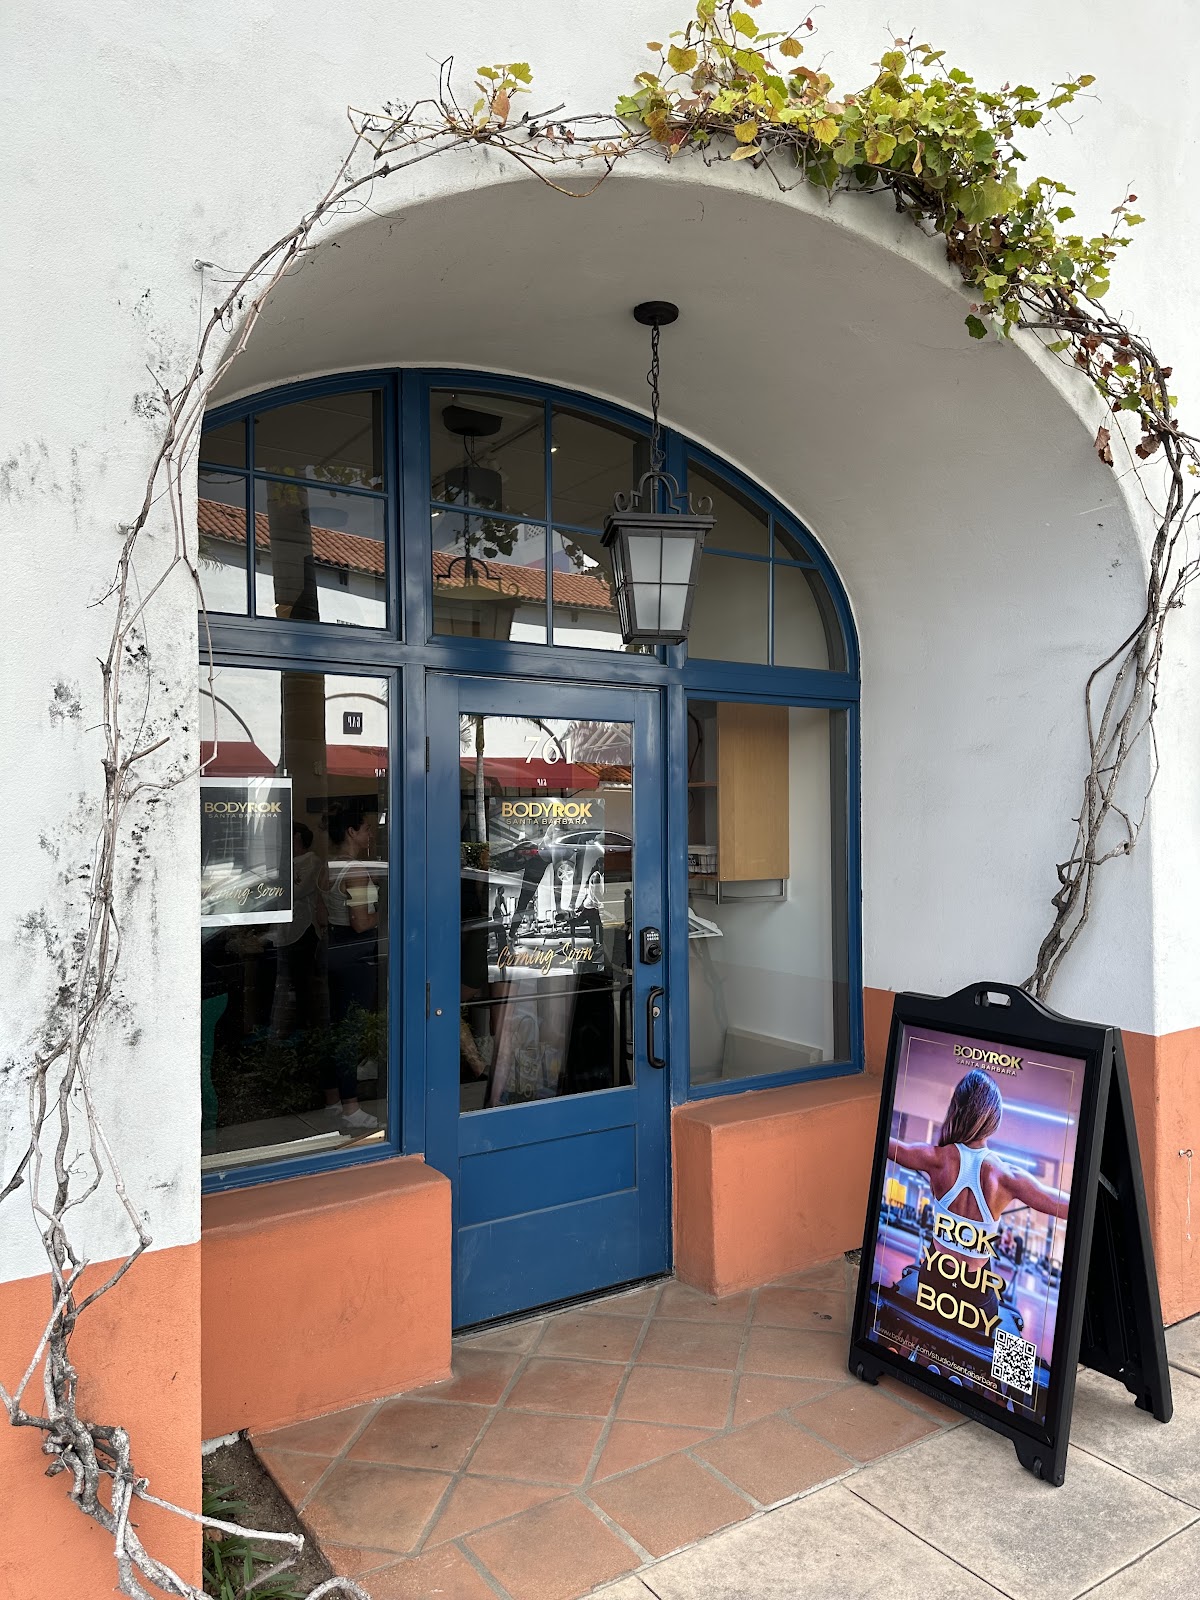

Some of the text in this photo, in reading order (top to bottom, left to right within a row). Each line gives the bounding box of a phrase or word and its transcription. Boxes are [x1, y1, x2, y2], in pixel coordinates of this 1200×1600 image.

[523, 734, 576, 765] 761
[204, 801, 282, 813] BODYROK
[501, 801, 593, 818] BODYROK
[506, 818, 588, 826] SANTA BARBARA
[254, 882, 285, 900] Soon
[497, 941, 594, 976] Coming Soon
[953, 1044, 1022, 1070] BODYROK
[955, 1057, 1017, 1076] SANTA BARBARA
[934, 1212, 1000, 1258] ROK
[923, 1245, 1006, 1301] YOUR
[916, 1282, 1002, 1337] BODY
[877, 1326, 998, 1390] www.bodyrok.com/studio/santabarbara
